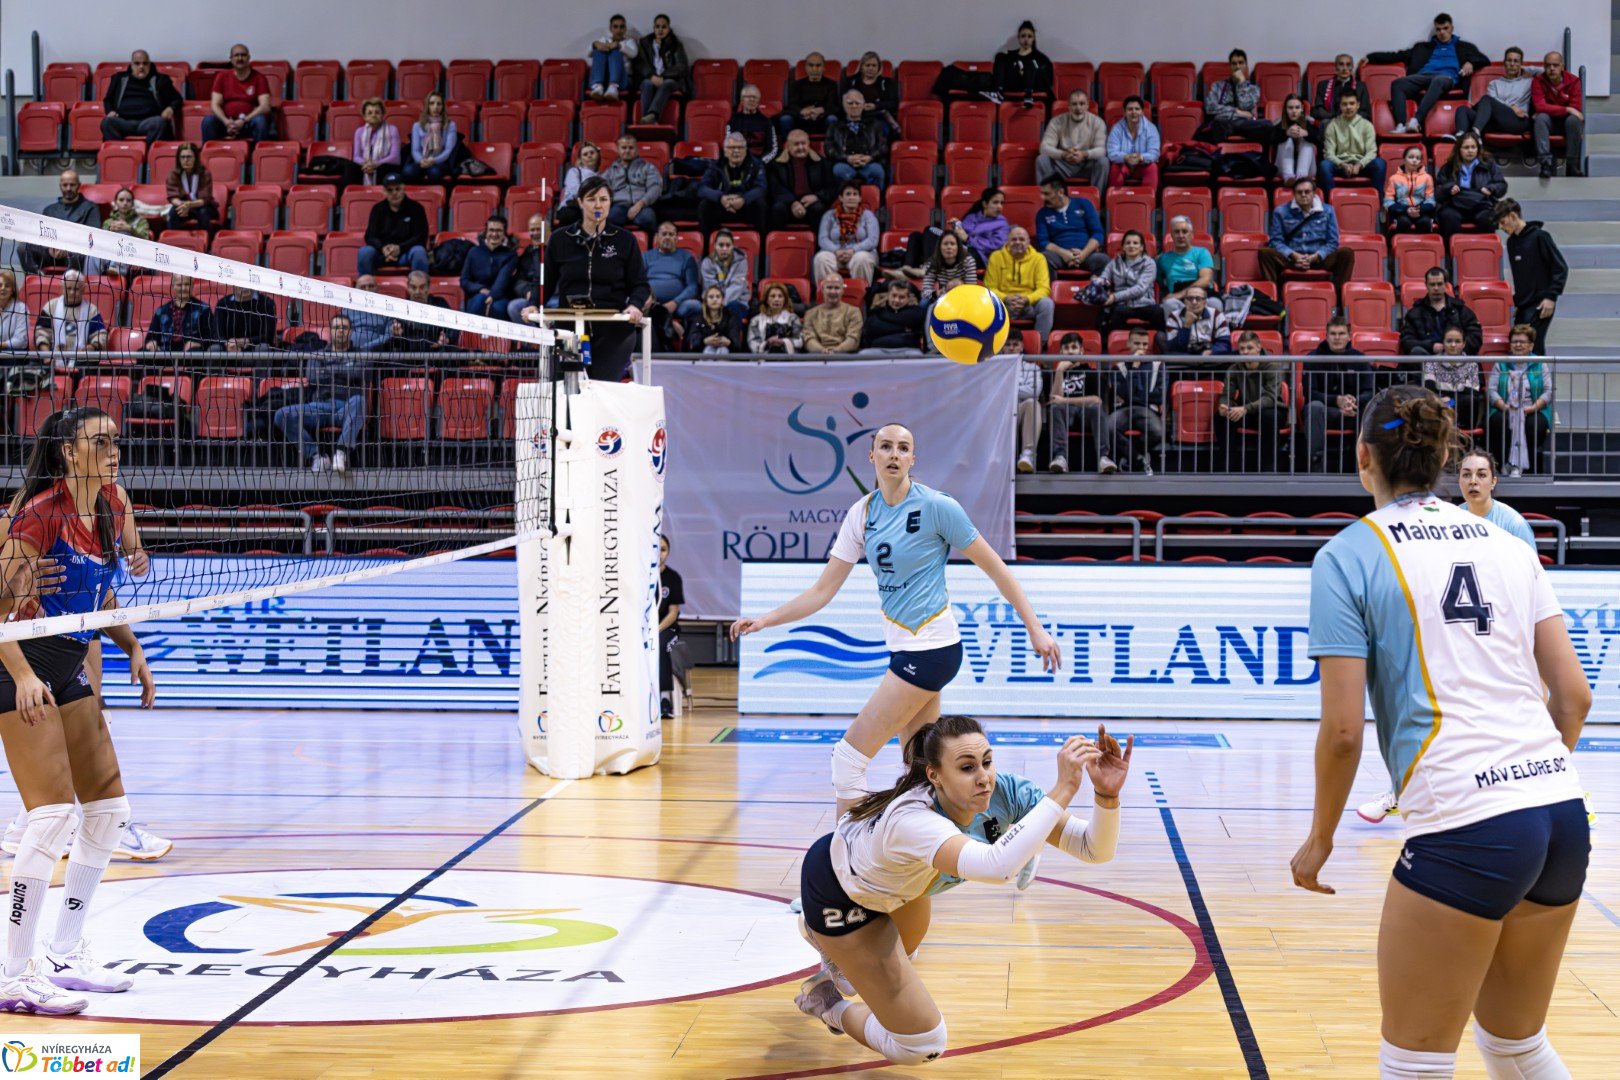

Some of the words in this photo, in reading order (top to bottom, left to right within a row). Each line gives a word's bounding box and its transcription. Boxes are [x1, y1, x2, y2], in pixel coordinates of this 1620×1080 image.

[1388, 519, 1489, 543] Maiorano
[876, 542, 893, 569] 2
[1440, 561, 1494, 636] 4
[1475, 767, 1508, 788] MÁV
[1553, 757, 1567, 773] SC
[10, 881, 28, 926] sunday
[822, 907, 868, 928] 24
